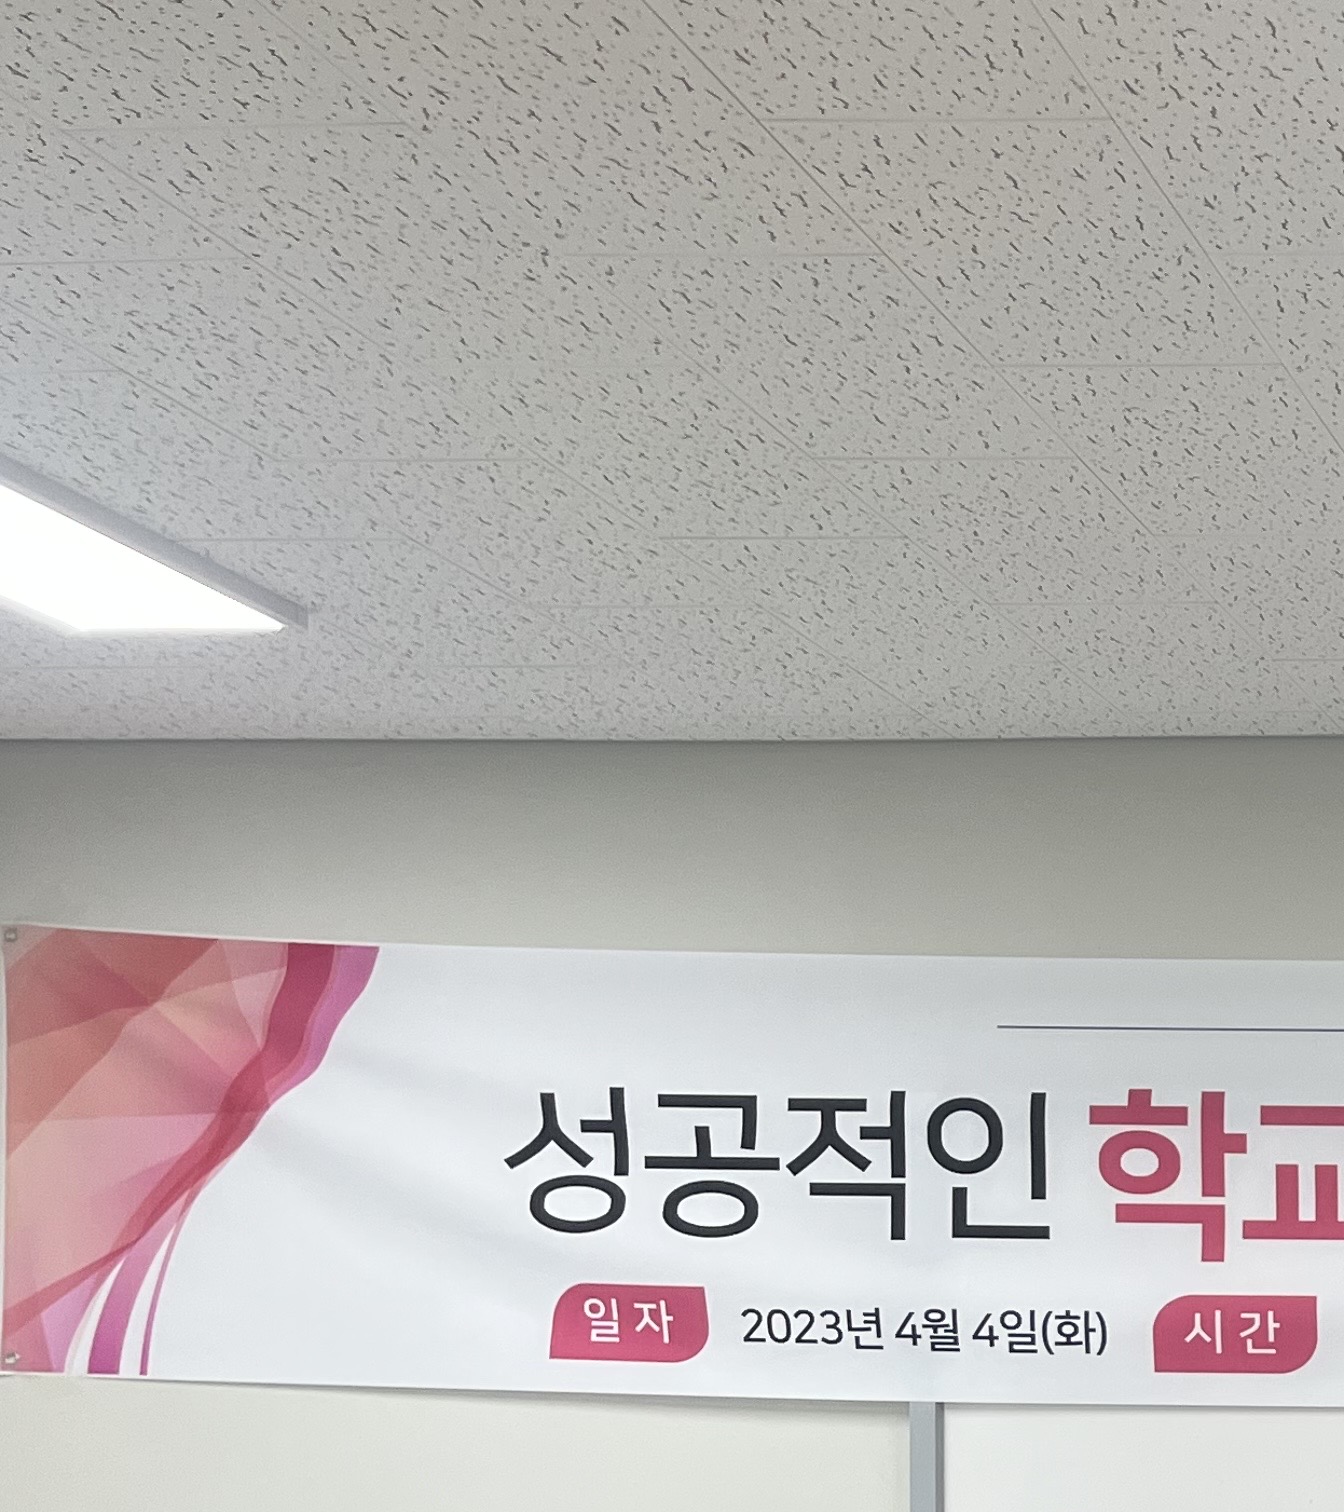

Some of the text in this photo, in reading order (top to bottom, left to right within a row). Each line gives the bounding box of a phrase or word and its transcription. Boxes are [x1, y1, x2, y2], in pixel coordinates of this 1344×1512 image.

[502, 1086, 1051, 1241] 성공적인
[740, 1306, 885, 1351] 2023년
[894, 1308, 961, 1353] 4월
[971, 1309, 1108, 1357] 4일(화)
